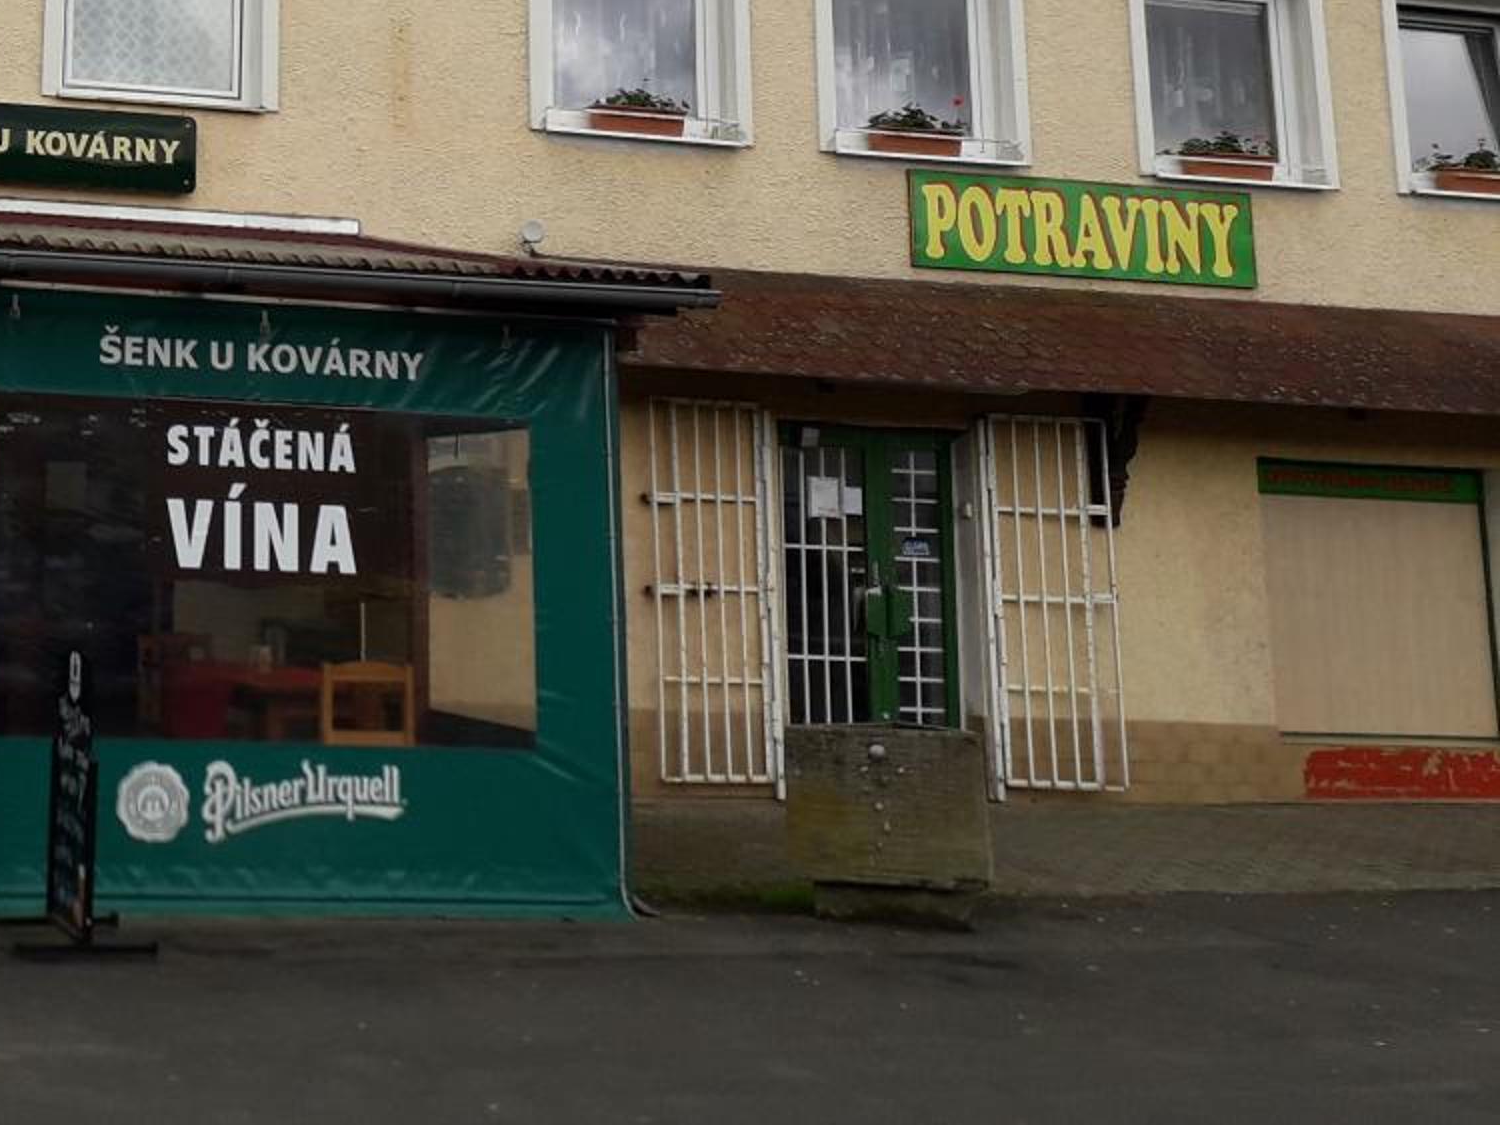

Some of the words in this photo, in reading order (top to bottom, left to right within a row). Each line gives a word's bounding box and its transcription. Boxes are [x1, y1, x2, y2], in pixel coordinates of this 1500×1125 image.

[25, 128, 181, 165] KOVÁRNY
[921, 182, 1239, 278] POTRAVINY
[99, 325, 198, 369] ŠENK
[210, 341, 235, 371] U
[247, 337, 425, 381] KOVÁRNY
[166, 417, 356, 474] STÁČENÁ
[166, 482, 357, 575] VÍNA
[202, 760, 306, 843] Pilsner
[301, 759, 401, 821] Urquell
